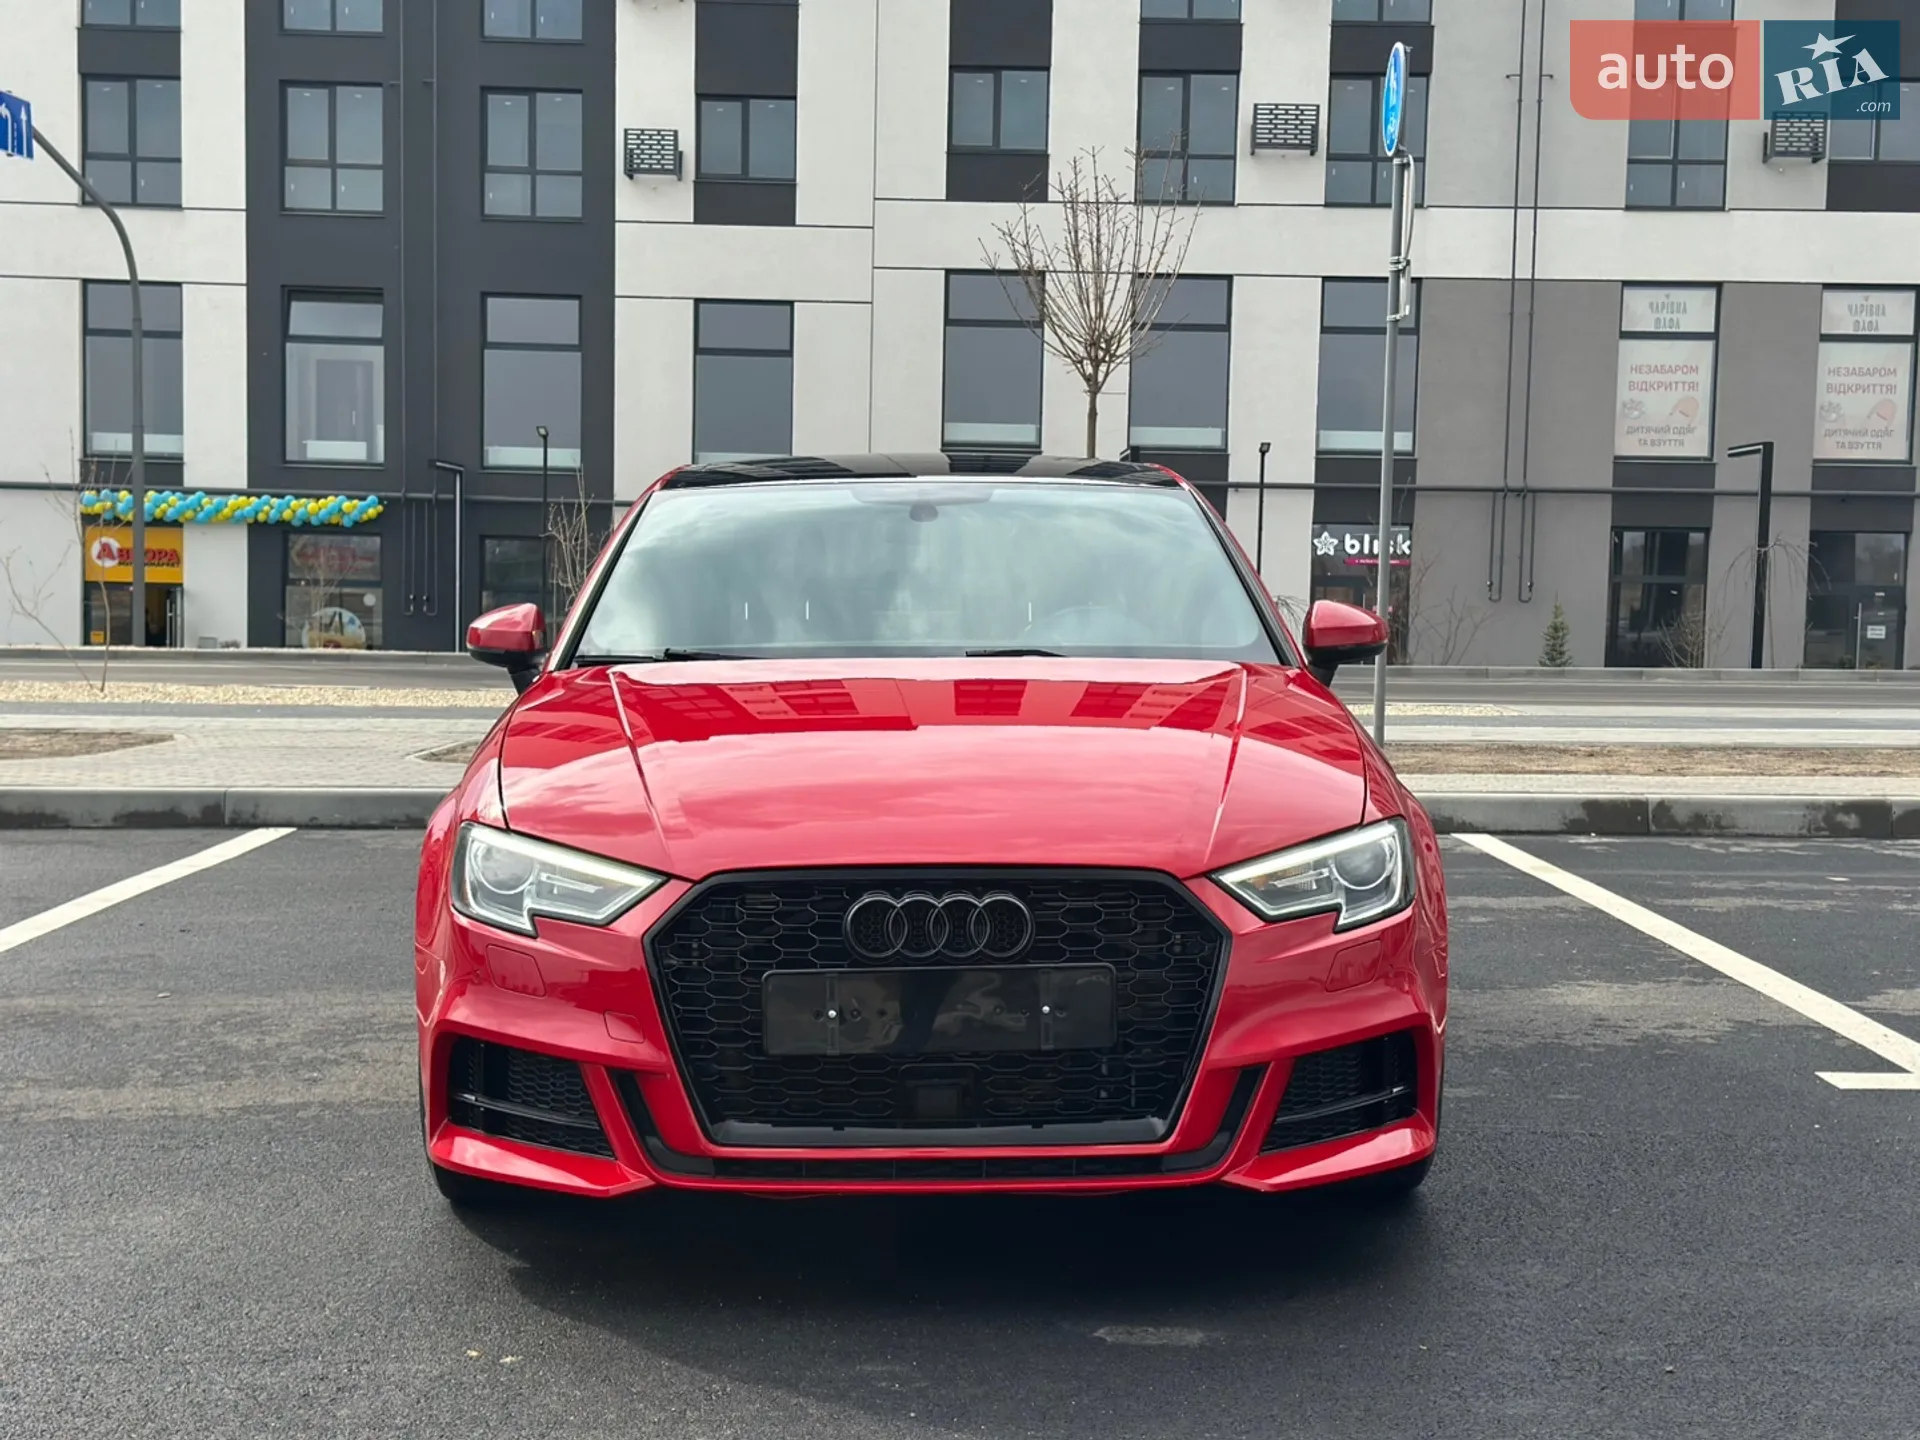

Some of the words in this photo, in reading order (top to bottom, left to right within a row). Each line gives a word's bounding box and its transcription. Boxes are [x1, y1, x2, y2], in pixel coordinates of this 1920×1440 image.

[1629, 363, 1699, 375] НЕЗАБАРОМ
[1827, 366, 1898, 378] НЕЗАБАРОМ
[1628, 380, 1699, 393] ВІДКРИТТЯ!
[1826, 382, 1897, 396] ВІДКРИТТЯ!
[1625, 424, 1671, 435] ДИТЯЧИЙ
[1824, 427, 1869, 438] ДИТЯЧИЙ
